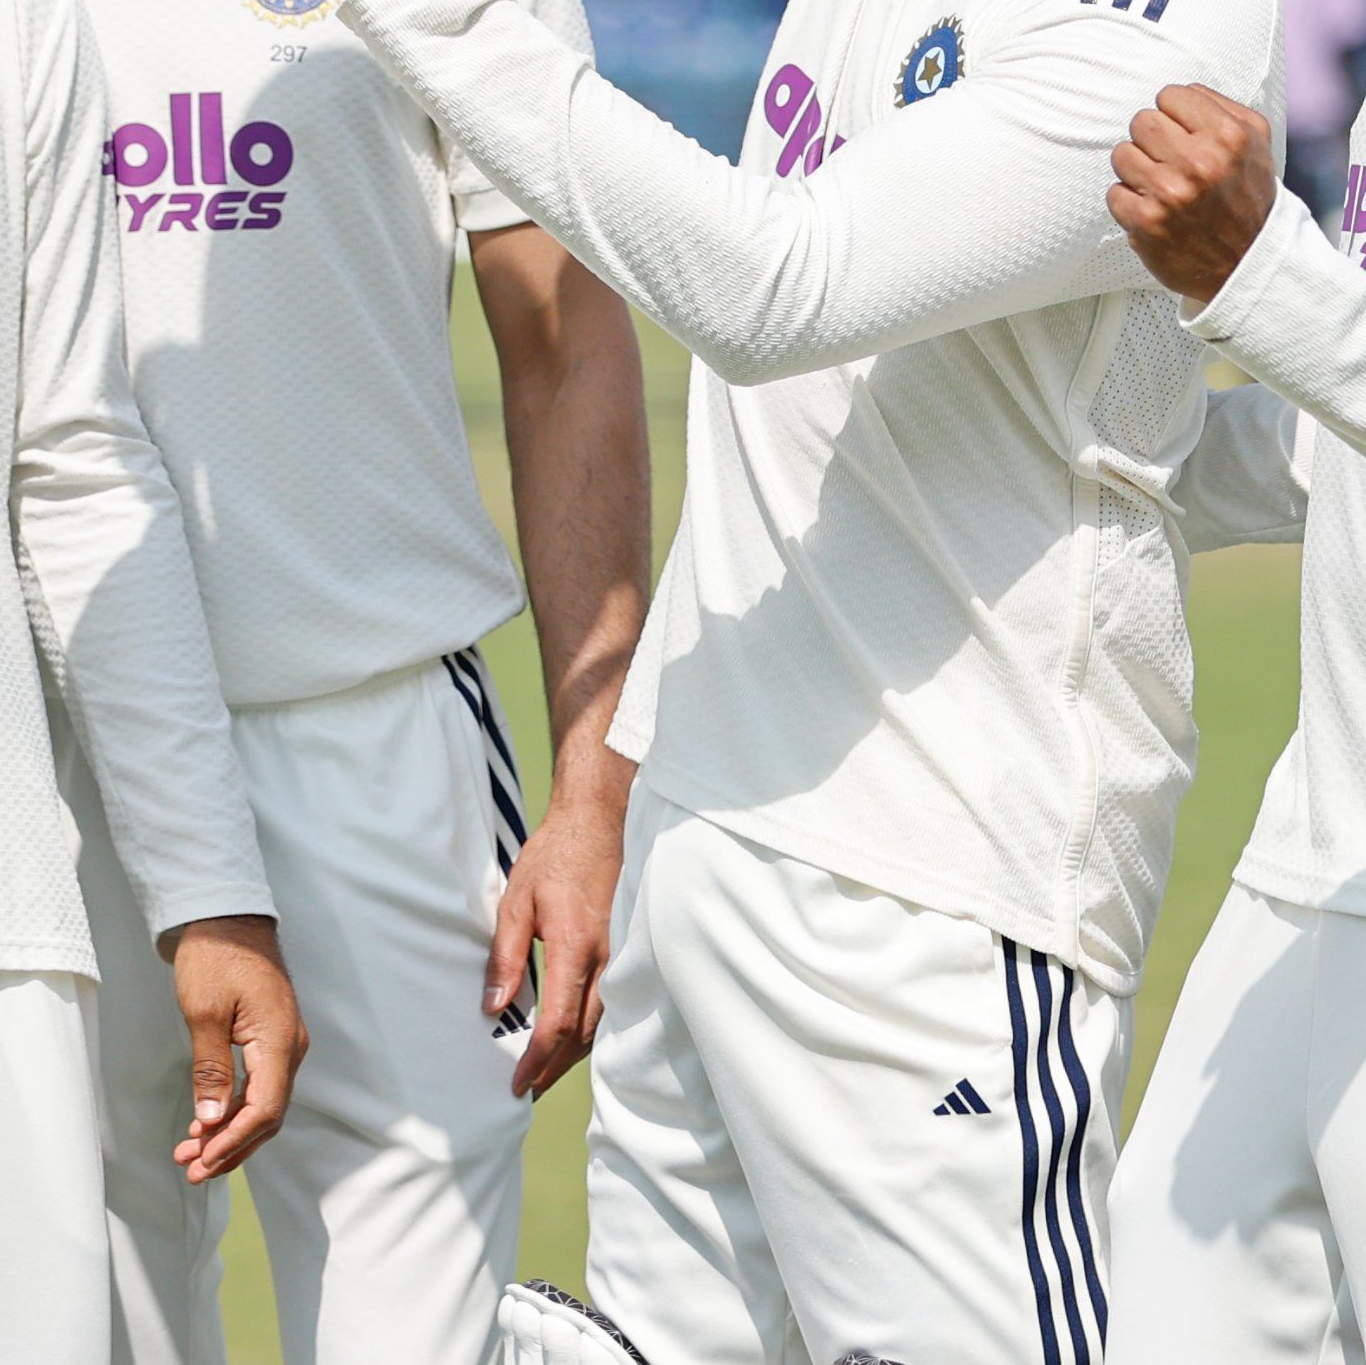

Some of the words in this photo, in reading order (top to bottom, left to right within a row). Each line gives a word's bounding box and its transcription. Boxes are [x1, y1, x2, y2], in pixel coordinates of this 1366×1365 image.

[270, 44, 308, 63] 297
[102, 92, 294, 187] ollo
[116, 191, 287, 232] YRES
